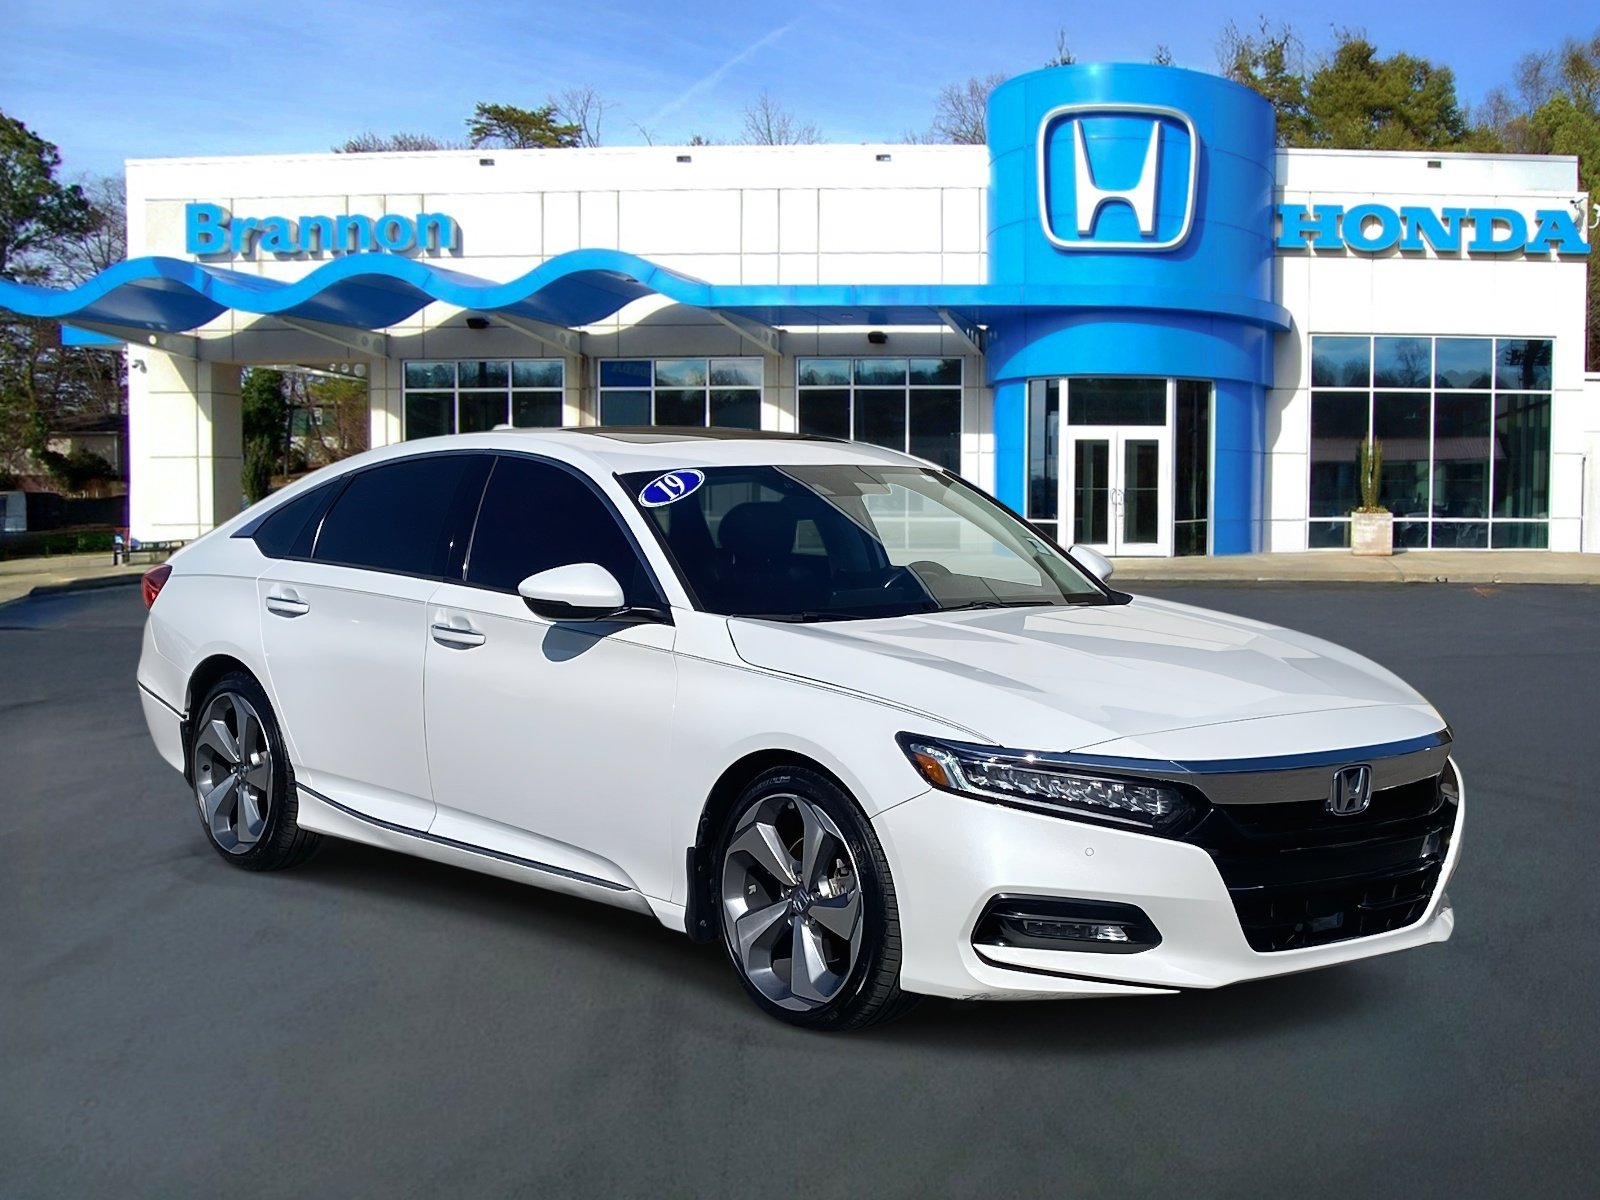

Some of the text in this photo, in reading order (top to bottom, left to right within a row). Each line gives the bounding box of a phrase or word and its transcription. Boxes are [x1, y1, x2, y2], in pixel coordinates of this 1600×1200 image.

[185, 202, 454, 254] Brannon
[1276, 203, 1591, 254] HONDA
[654, 474, 686, 501] 19
